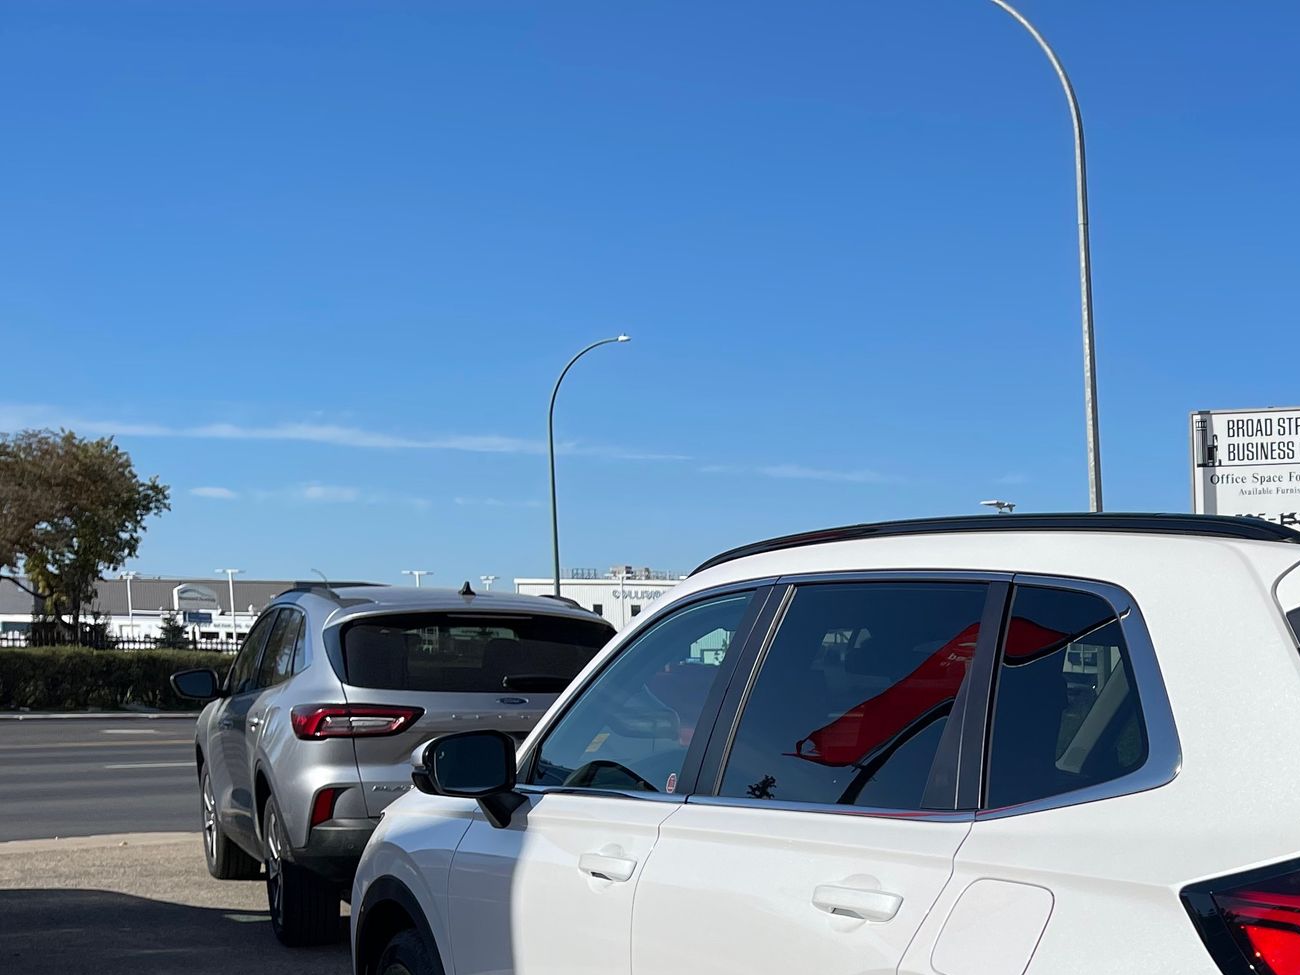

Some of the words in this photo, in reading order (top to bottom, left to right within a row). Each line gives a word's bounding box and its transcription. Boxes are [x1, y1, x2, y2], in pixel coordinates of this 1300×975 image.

[1227, 418, 1273, 438] BROAD
[1227, 441, 1295, 461] BUSINESS
[1210, 473, 1247, 485] Office
[1252, 472, 1284, 485] Space
[1239, 487, 1273, 496] Available
